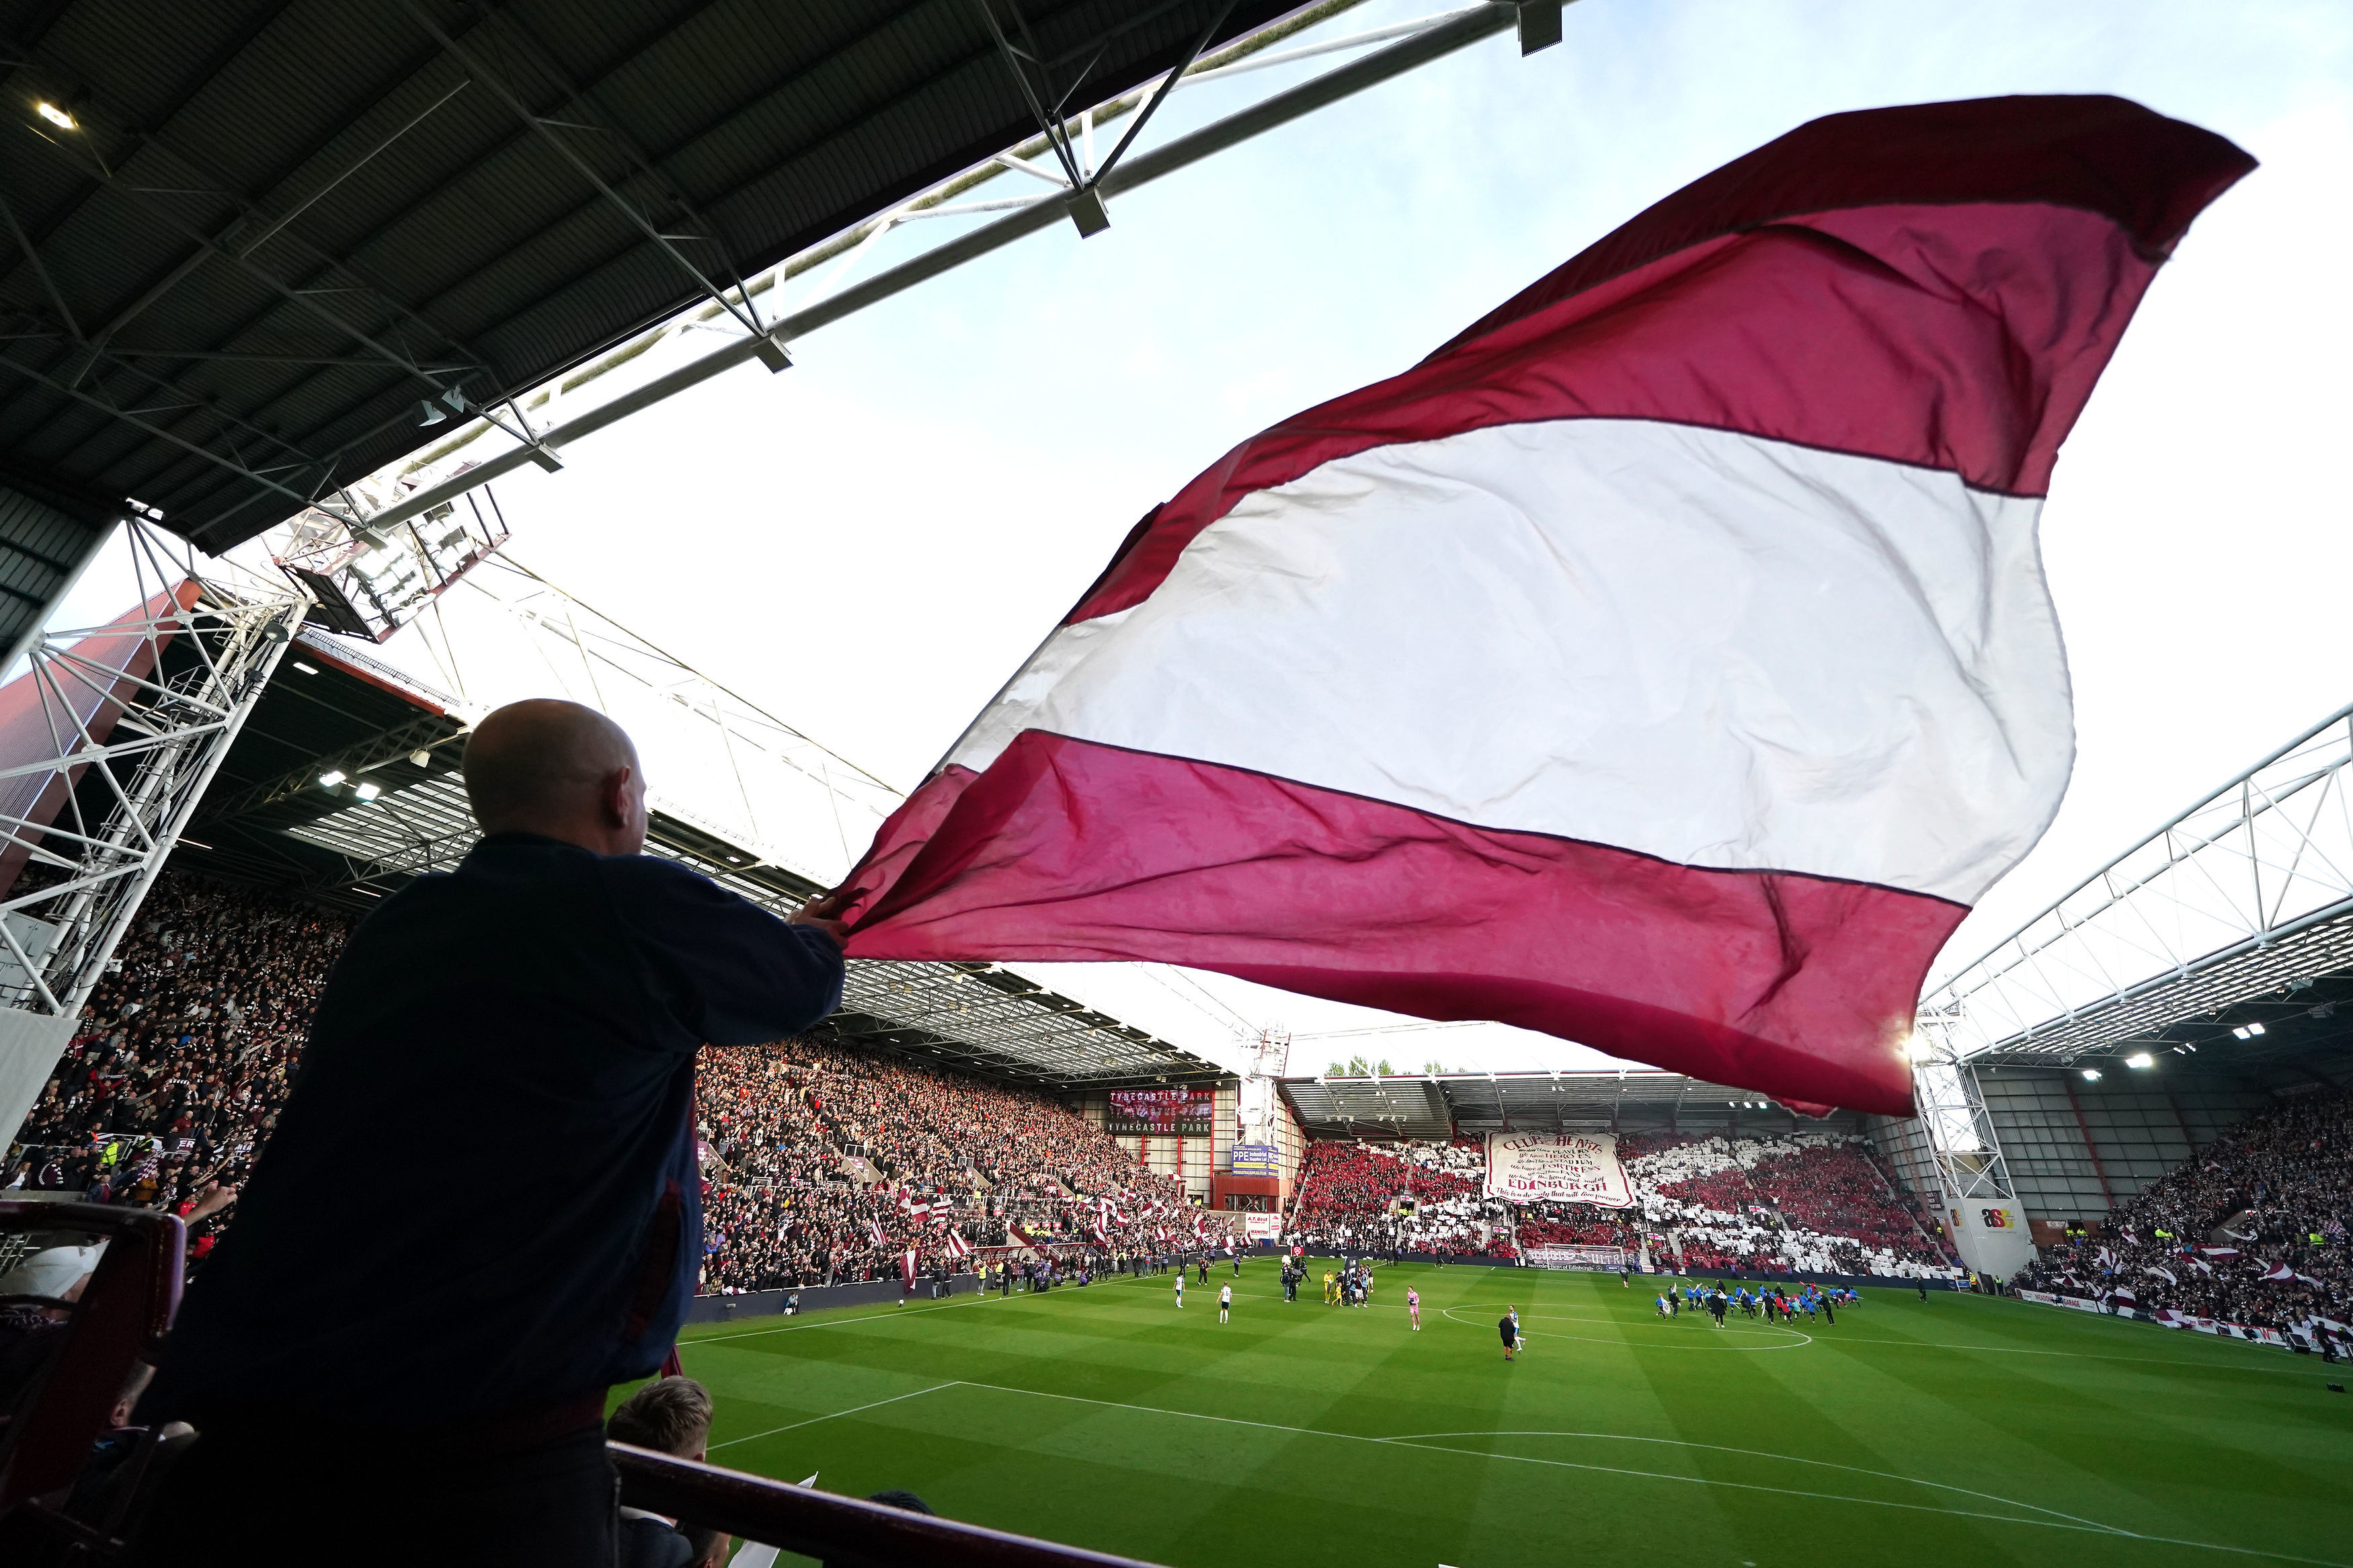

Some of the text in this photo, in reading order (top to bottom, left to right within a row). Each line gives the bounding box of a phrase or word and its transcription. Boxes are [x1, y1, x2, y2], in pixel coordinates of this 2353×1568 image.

[1110, 1092, 1209, 1101] TYNECASTLE PARK
[1109, 1123, 1209, 1132] TYNECASTLE PARK
[1556, 1136, 1602, 1154] HEARTS
[1234, 1151, 1249, 1161] PPE
[1543, 1163, 1601, 1173] FORTRESS
[1509, 1179, 1607, 1192] EDINBURGH
[1496, 1187, 1509, 1196] This
